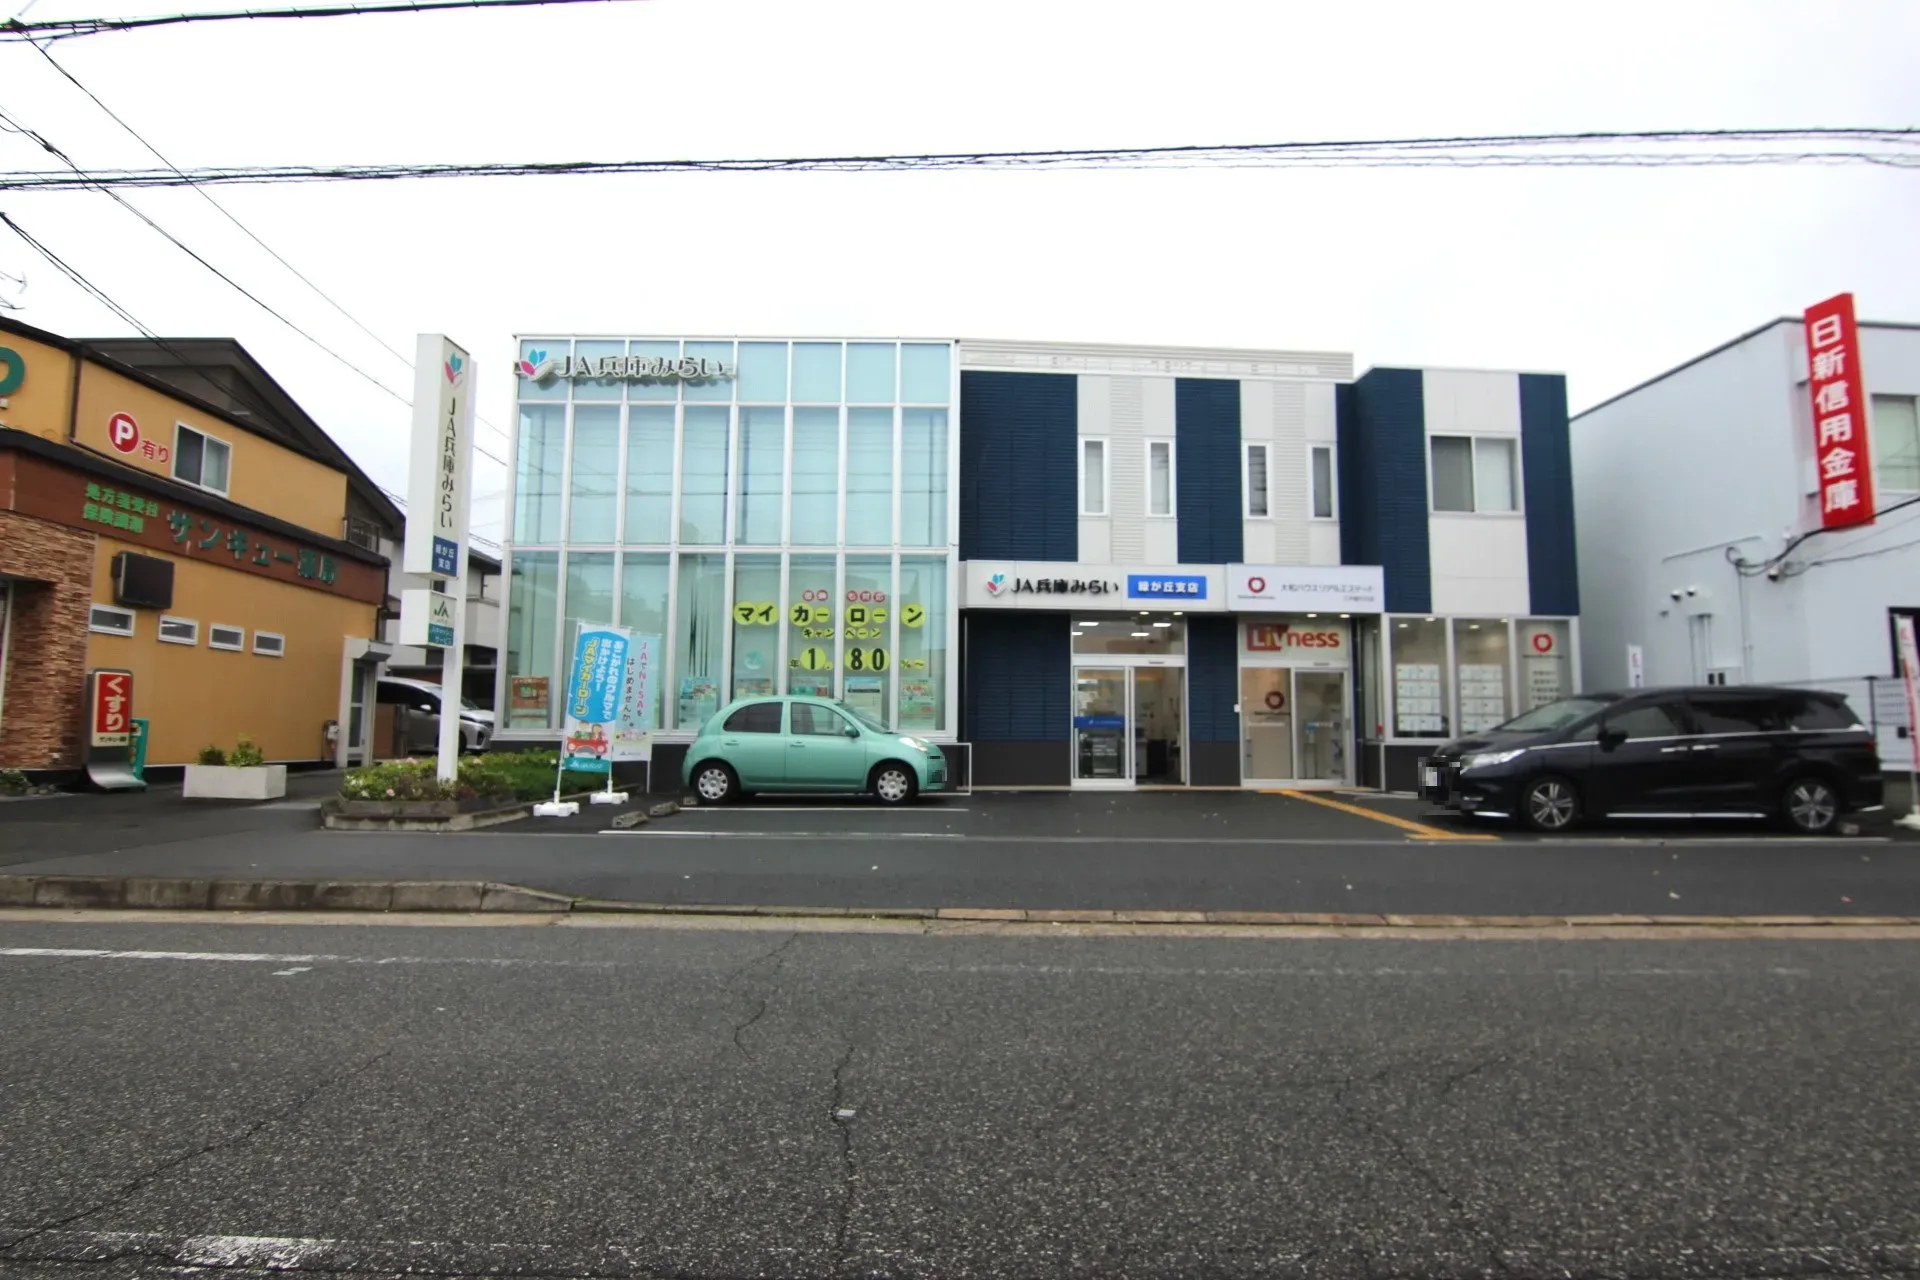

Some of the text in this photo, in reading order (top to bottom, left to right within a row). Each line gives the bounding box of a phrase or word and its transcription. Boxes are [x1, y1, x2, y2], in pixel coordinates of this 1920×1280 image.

[556, 355, 724, 377] JA兵庫みらい
[1811, 314, 1859, 513] 日新信用金庫
[142, 438, 169, 463] 有り
[441, 397, 456, 528] JA兵庫みらい
[1011, 578, 1119, 595] JA兵庫みらい
[1137, 580, 1199, 594] 緑が丘支店
[1252, 625, 1340, 649] Livness
[622, 658, 635, 722] はじめませんか
[104, 676, 126, 732] くすり
